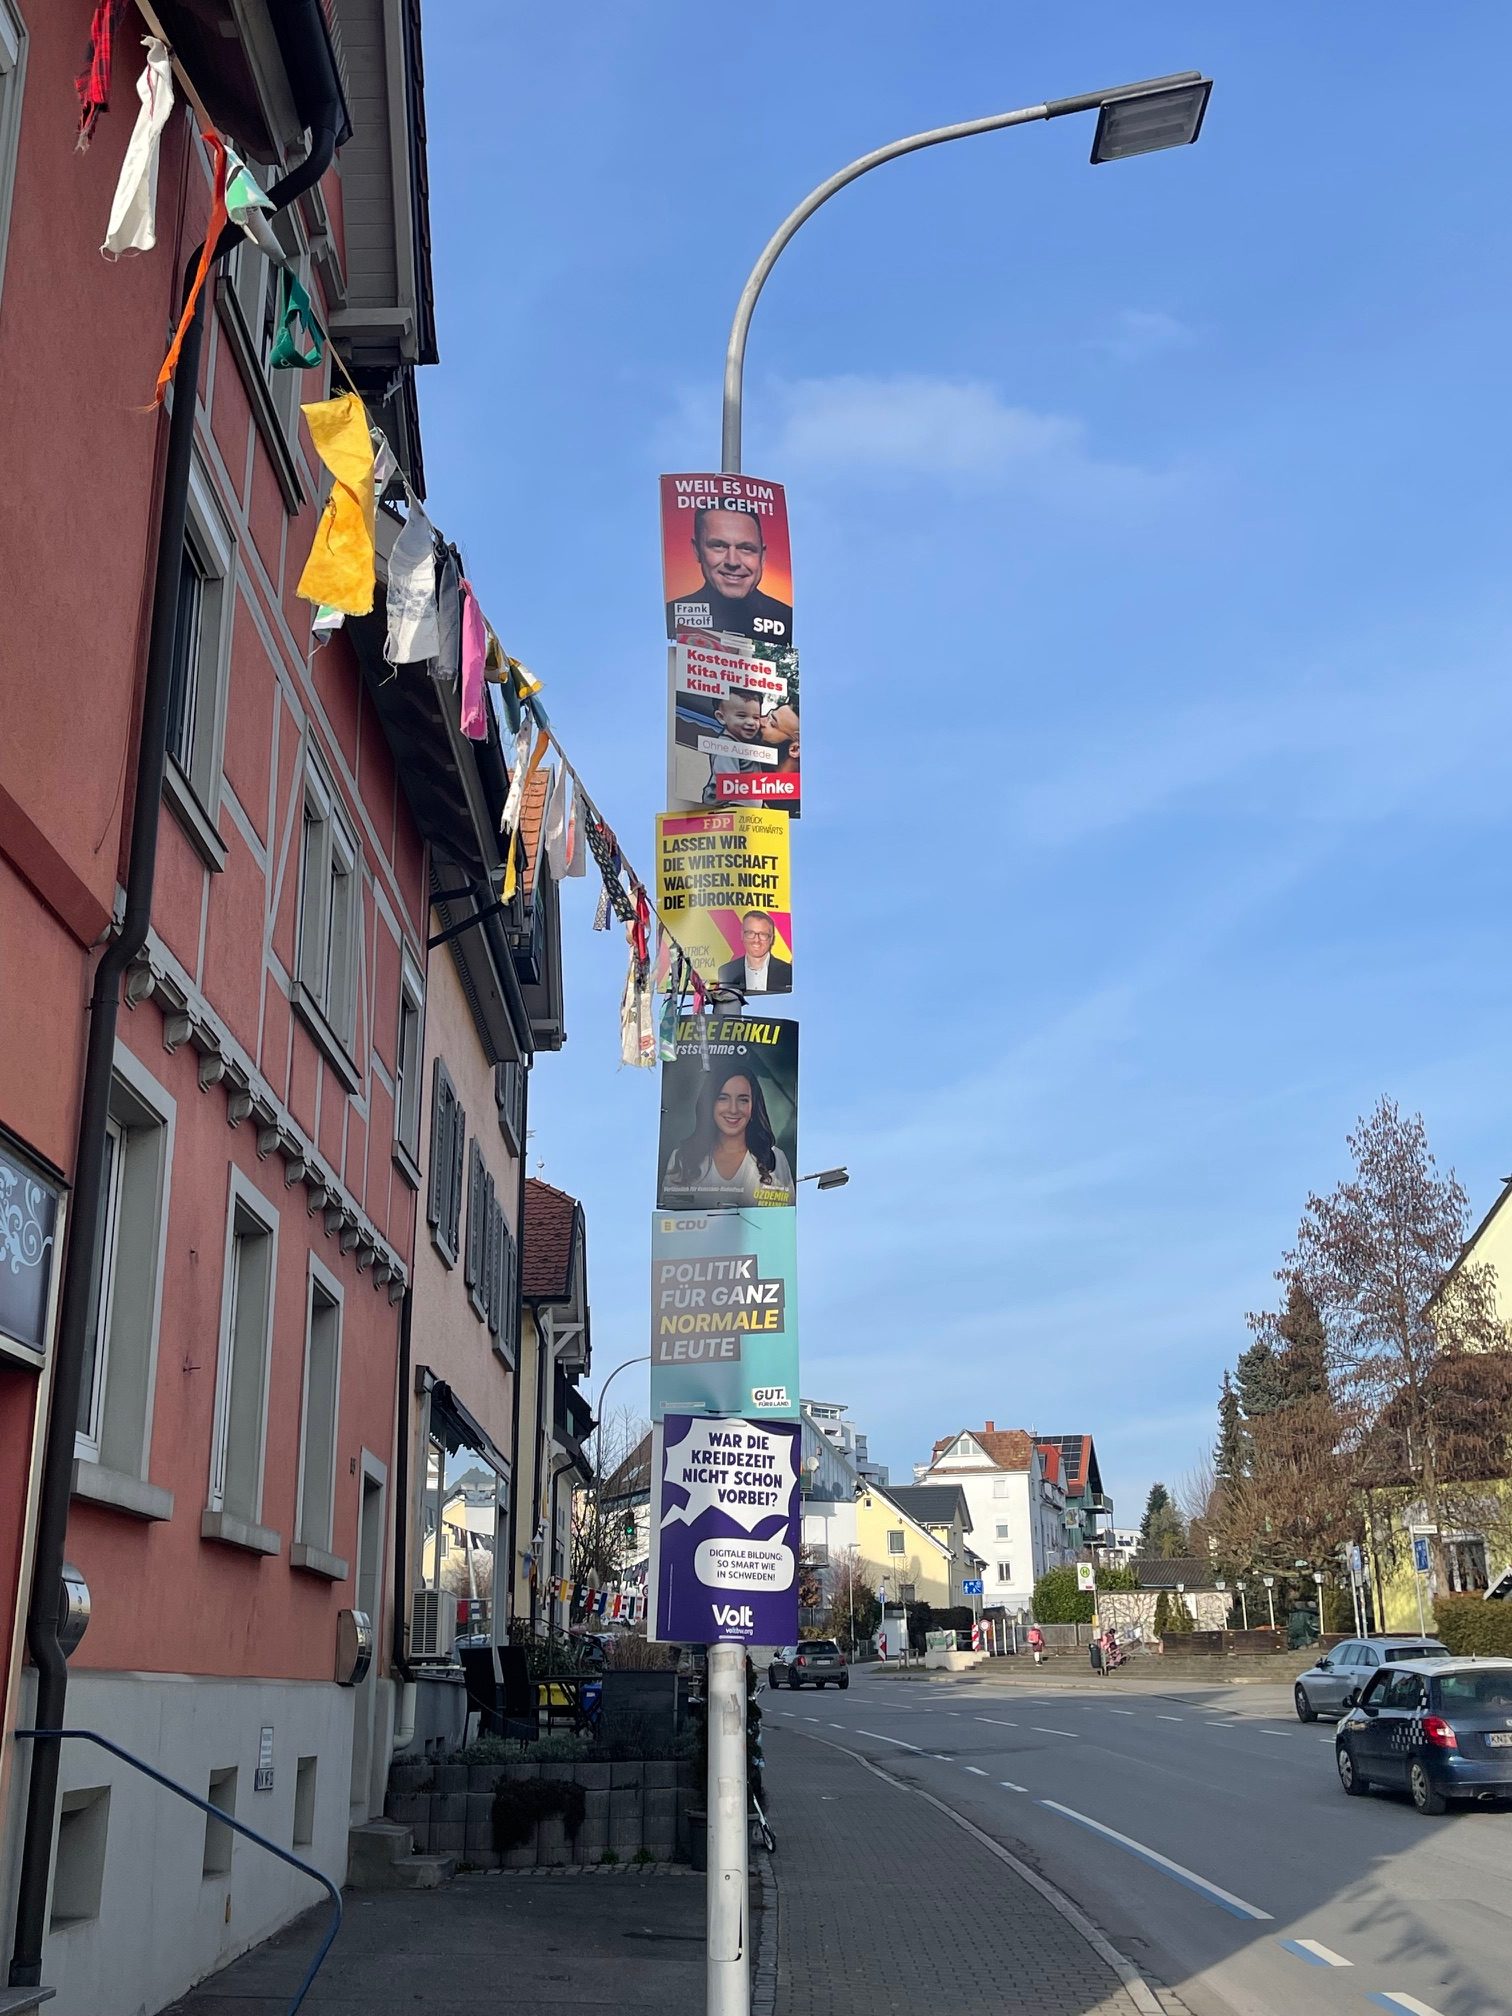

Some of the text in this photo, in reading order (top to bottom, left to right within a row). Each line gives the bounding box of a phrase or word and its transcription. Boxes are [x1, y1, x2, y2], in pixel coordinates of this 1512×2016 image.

[675, 480, 774, 500] WEIL ES UM
[677, 496, 774, 516] DICH GEHT!
[677, 604, 708, 613] Frank
[677, 616, 711, 625] Ortolf
[753, 617, 785, 635] SPD
[687, 649, 772, 675] Kostenfreie
[687, 664, 783, 692] Kita für jedes
[687, 679, 725, 695] Kind.
[702, 740, 729, 752] Ohne
[723, 777, 794, 794] Die Linke
[703, 818, 731, 829] FDP
[739, 814, 763, 824] ZURÜCK
[751, 825, 783, 835] VORWÄRTS
[663, 836, 747, 854] LASSEN WIR
[663, 854, 778, 872] DIE WIRTSCHAFT
[664, 873, 779, 891] WACHSEN. NICHT
[664, 888, 779, 910] DIE BÜROKRATIE.
[720, 1022, 781, 1045] ERIKLI
[676, 1220, 707, 1230] CDU
[660, 1259, 753, 1283] POLITIK
[660, 1283, 779, 1309] FÜR GANZ
[660, 1309, 779, 1335] NORMALE
[660, 1337, 735, 1360] LEUTE
[754, 1389, 785, 1400] GUT.
[709, 1432, 770, 1450] WAR DIE
[691, 1450, 775, 1469] KREIDEZEIT
[682, 1468, 782, 1488] NICHT SCHON
[717, 1489, 778, 1507] VORBEI?
[709, 1549, 783, 1561] DIGITALE BILDUNG:
[717, 1560, 776, 1570] SO SMART WIE
[728, 1571, 776, 1581] SCHWEDEN!
[711, 1604, 754, 1627] Volt
